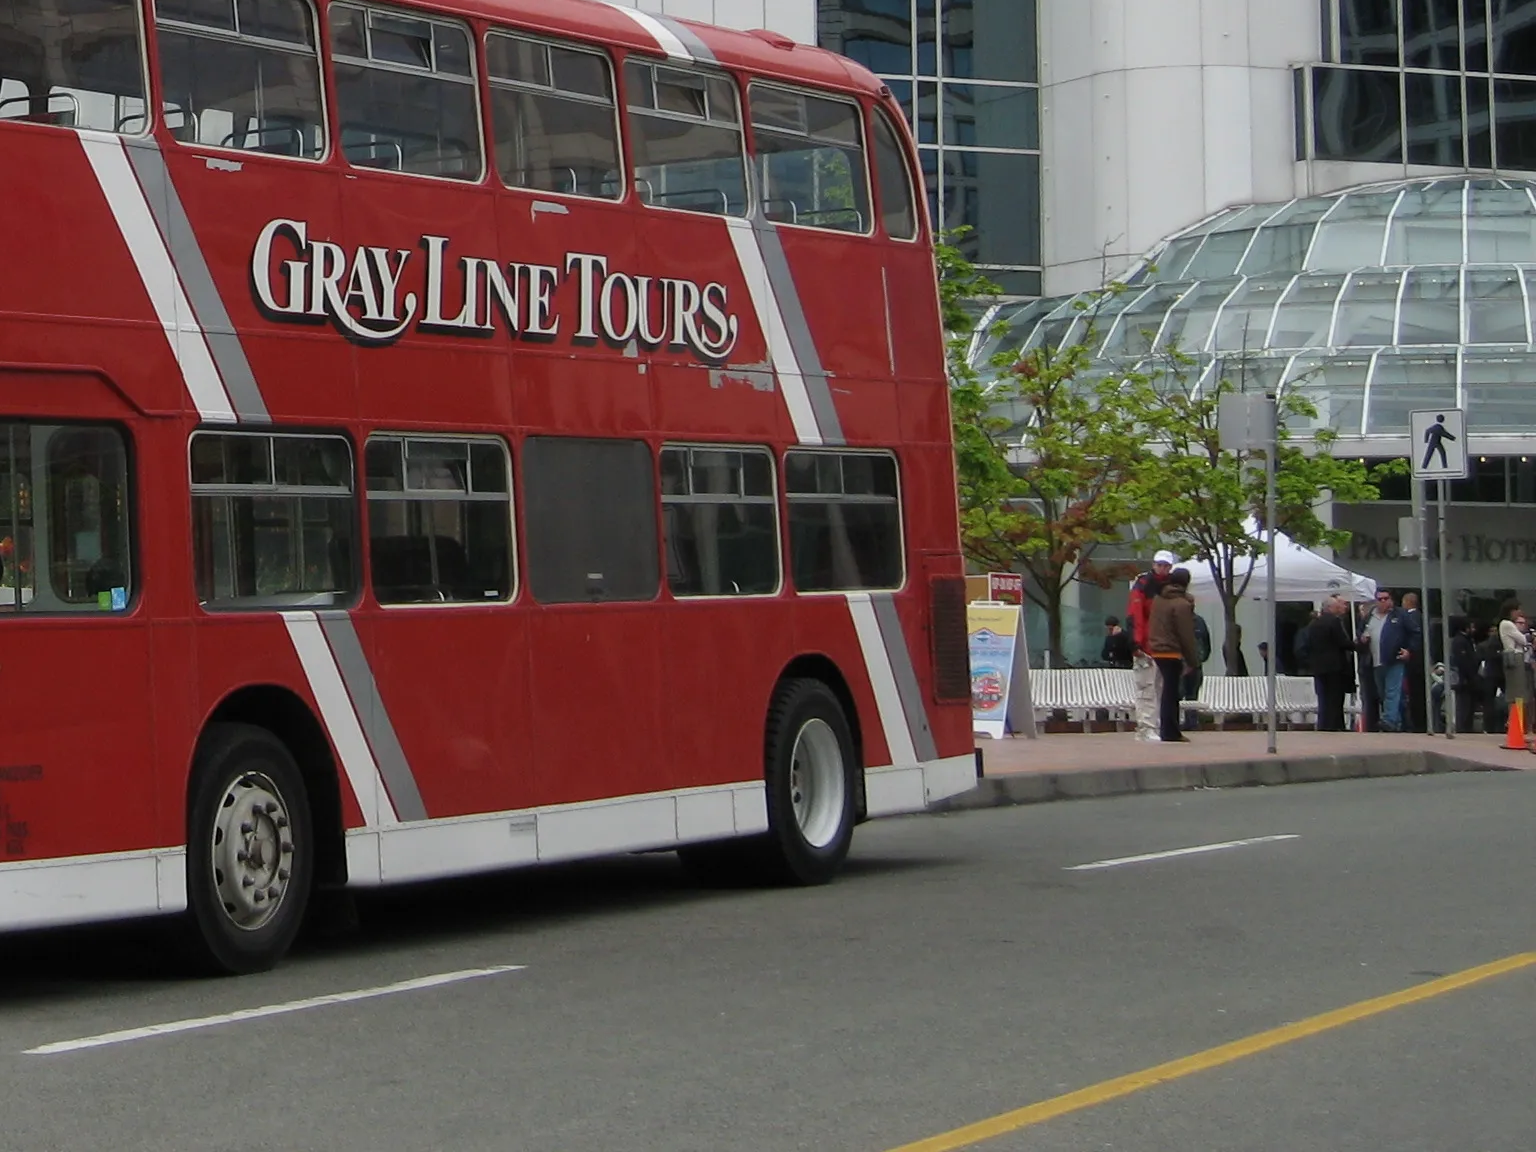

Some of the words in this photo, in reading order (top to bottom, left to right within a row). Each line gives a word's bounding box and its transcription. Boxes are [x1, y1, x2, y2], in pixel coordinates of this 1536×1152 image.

[252, 218, 418, 340] GRAY
[419, 234, 560, 335] LINE
[565, 251, 739, 359] TOURS
